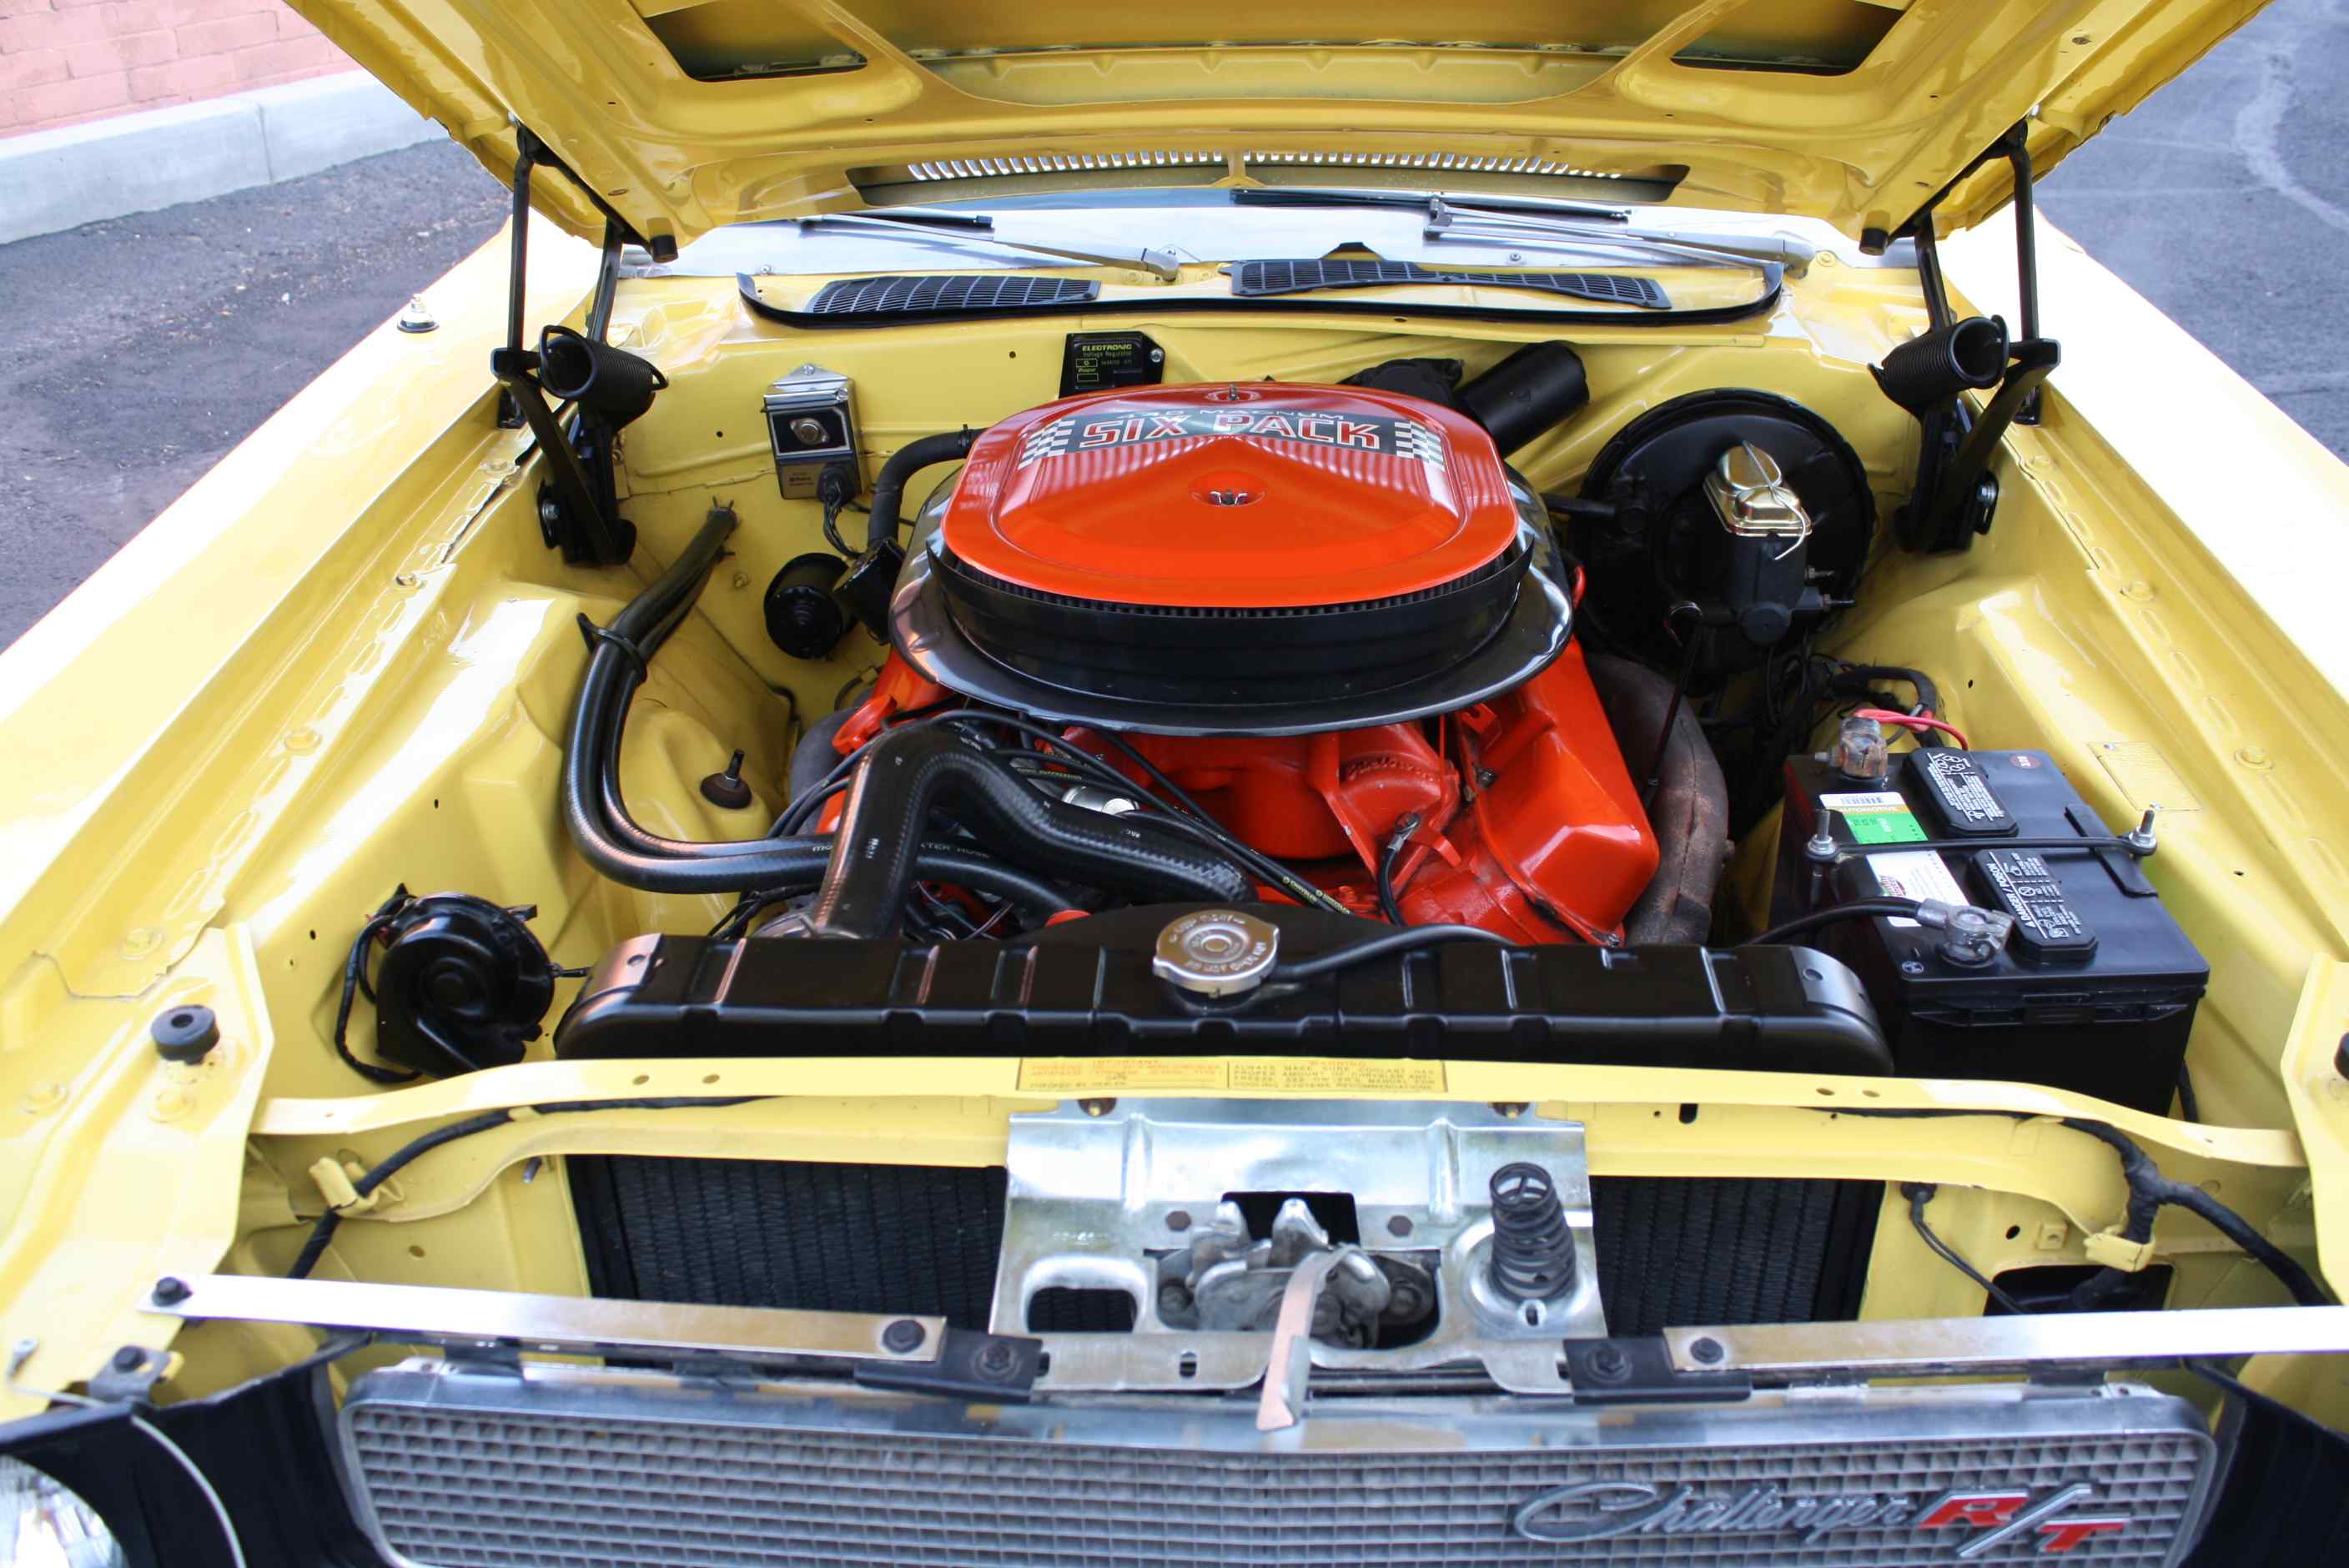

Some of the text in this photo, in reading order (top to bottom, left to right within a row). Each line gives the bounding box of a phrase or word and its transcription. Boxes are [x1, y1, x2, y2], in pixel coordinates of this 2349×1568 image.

[1079, 414, 1381, 450] SIX PACK
[1986, 862, 2011, 887] POISON
[2006, 893, 2032, 921] DANGER
[1515, 1482, 2130, 1558] Challenger R/T
